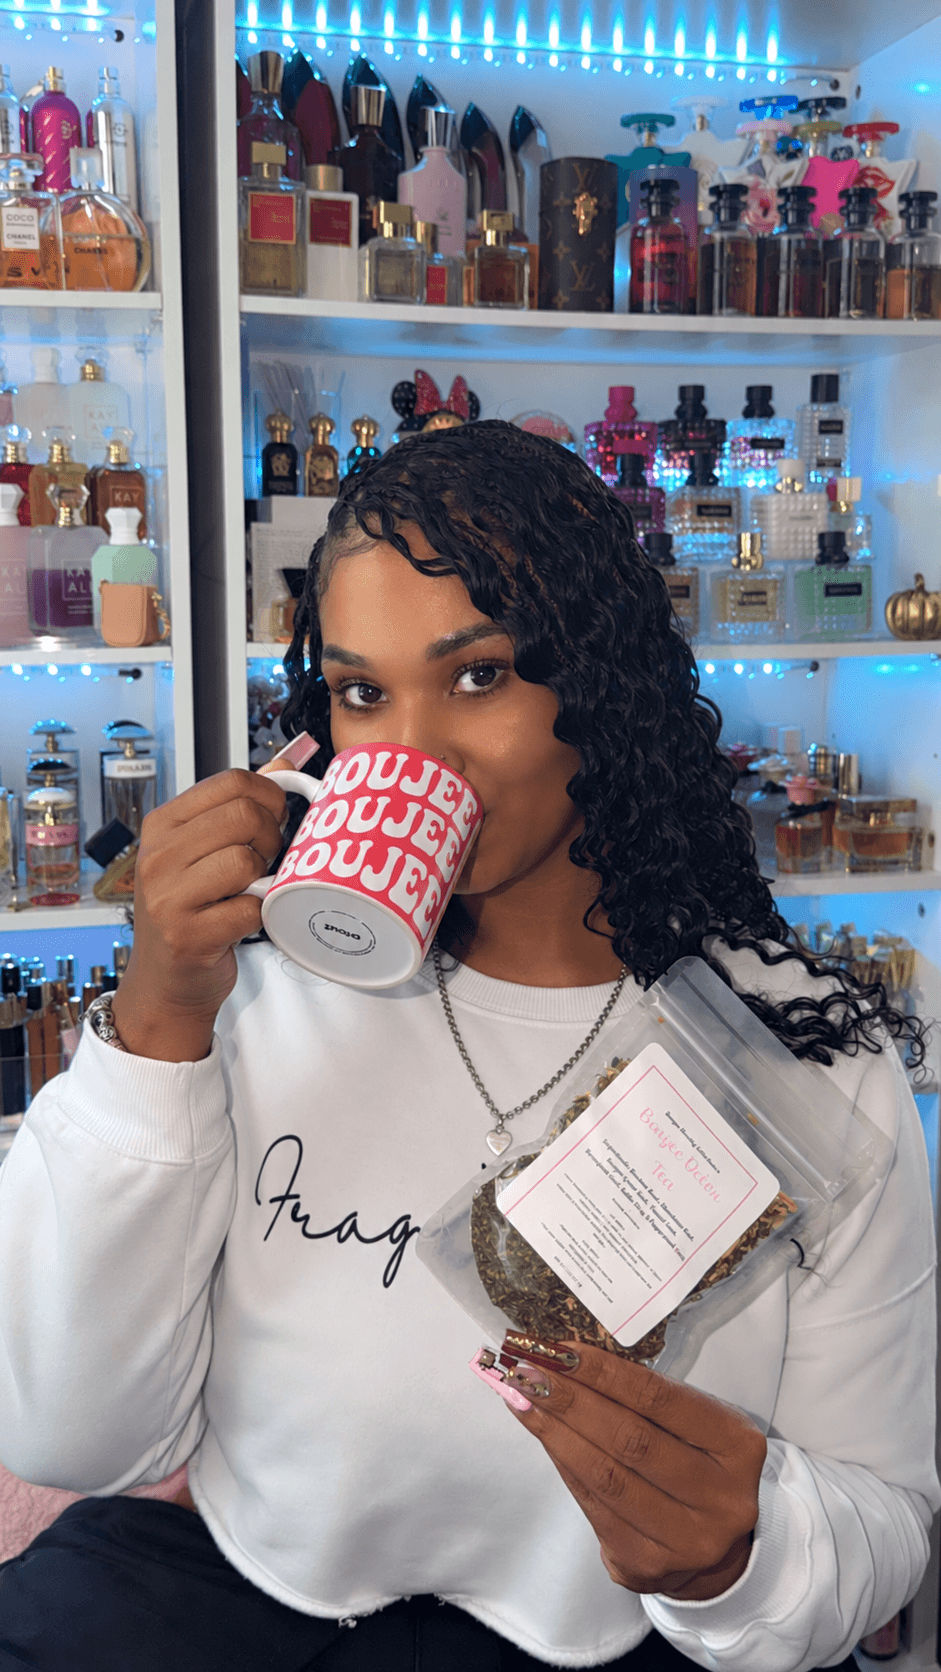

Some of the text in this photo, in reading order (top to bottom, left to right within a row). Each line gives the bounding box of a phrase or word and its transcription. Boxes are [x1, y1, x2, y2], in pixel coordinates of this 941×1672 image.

[6, 213, 35, 222] COCO
[6, 233, 37, 241] CHANEL
[313, 750, 478, 841] BOUJEE
[290, 796, 461, 882] BOUJEE
[271, 839, 442, 940] BOUJEE
[255, 1134, 421, 1289] Frag
[650, 1159, 676, 1192] Tea
